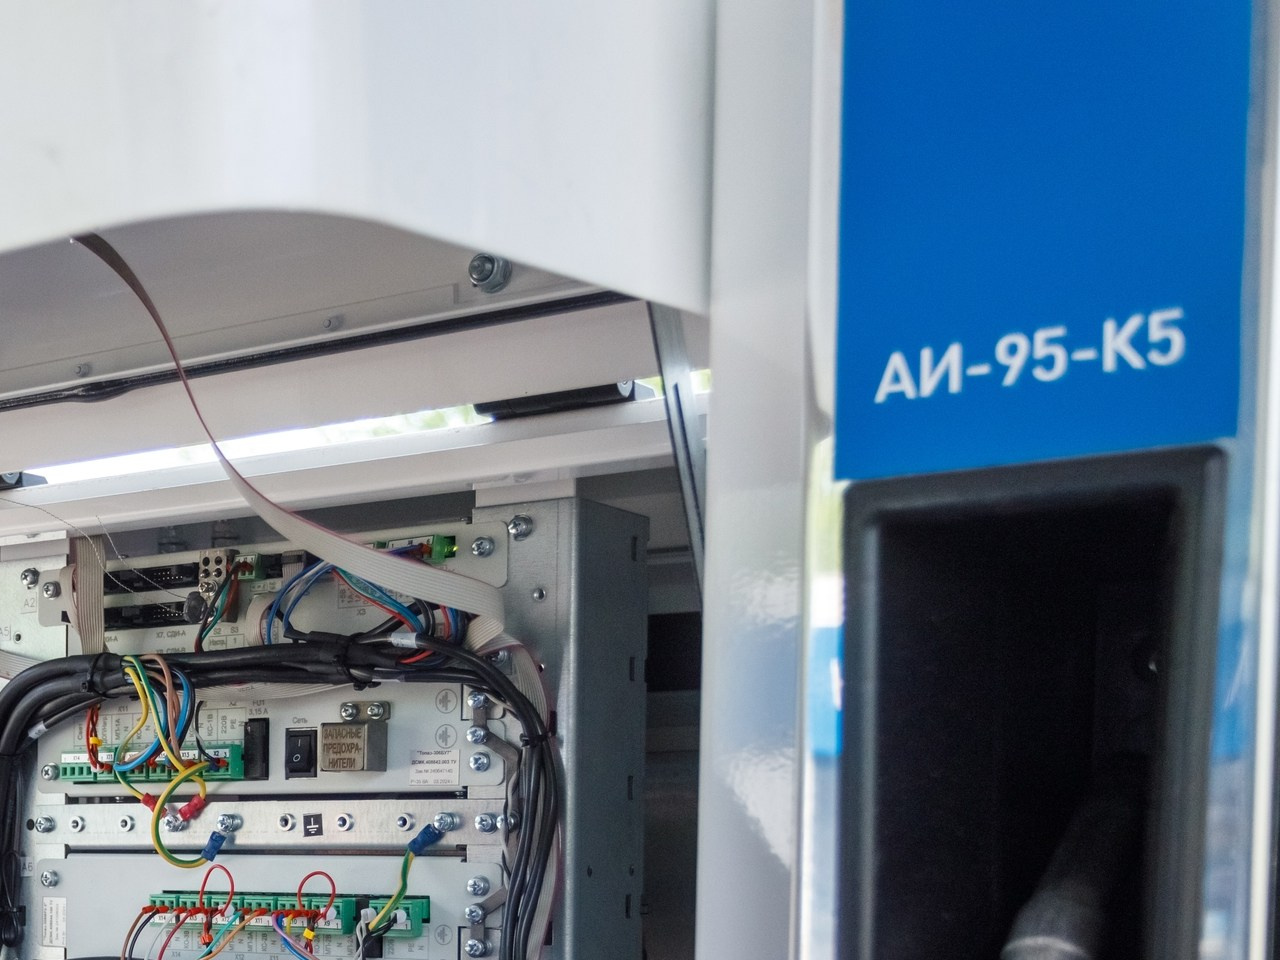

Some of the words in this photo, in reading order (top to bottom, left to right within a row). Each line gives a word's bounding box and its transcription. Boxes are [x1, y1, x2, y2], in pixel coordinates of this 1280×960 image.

[874, 307, 1187, 404] АИ-95-К5
[323, 727, 362, 739] ЗАПАСНЫЕ
[328, 757, 356, 769] НИТЕЛИ
